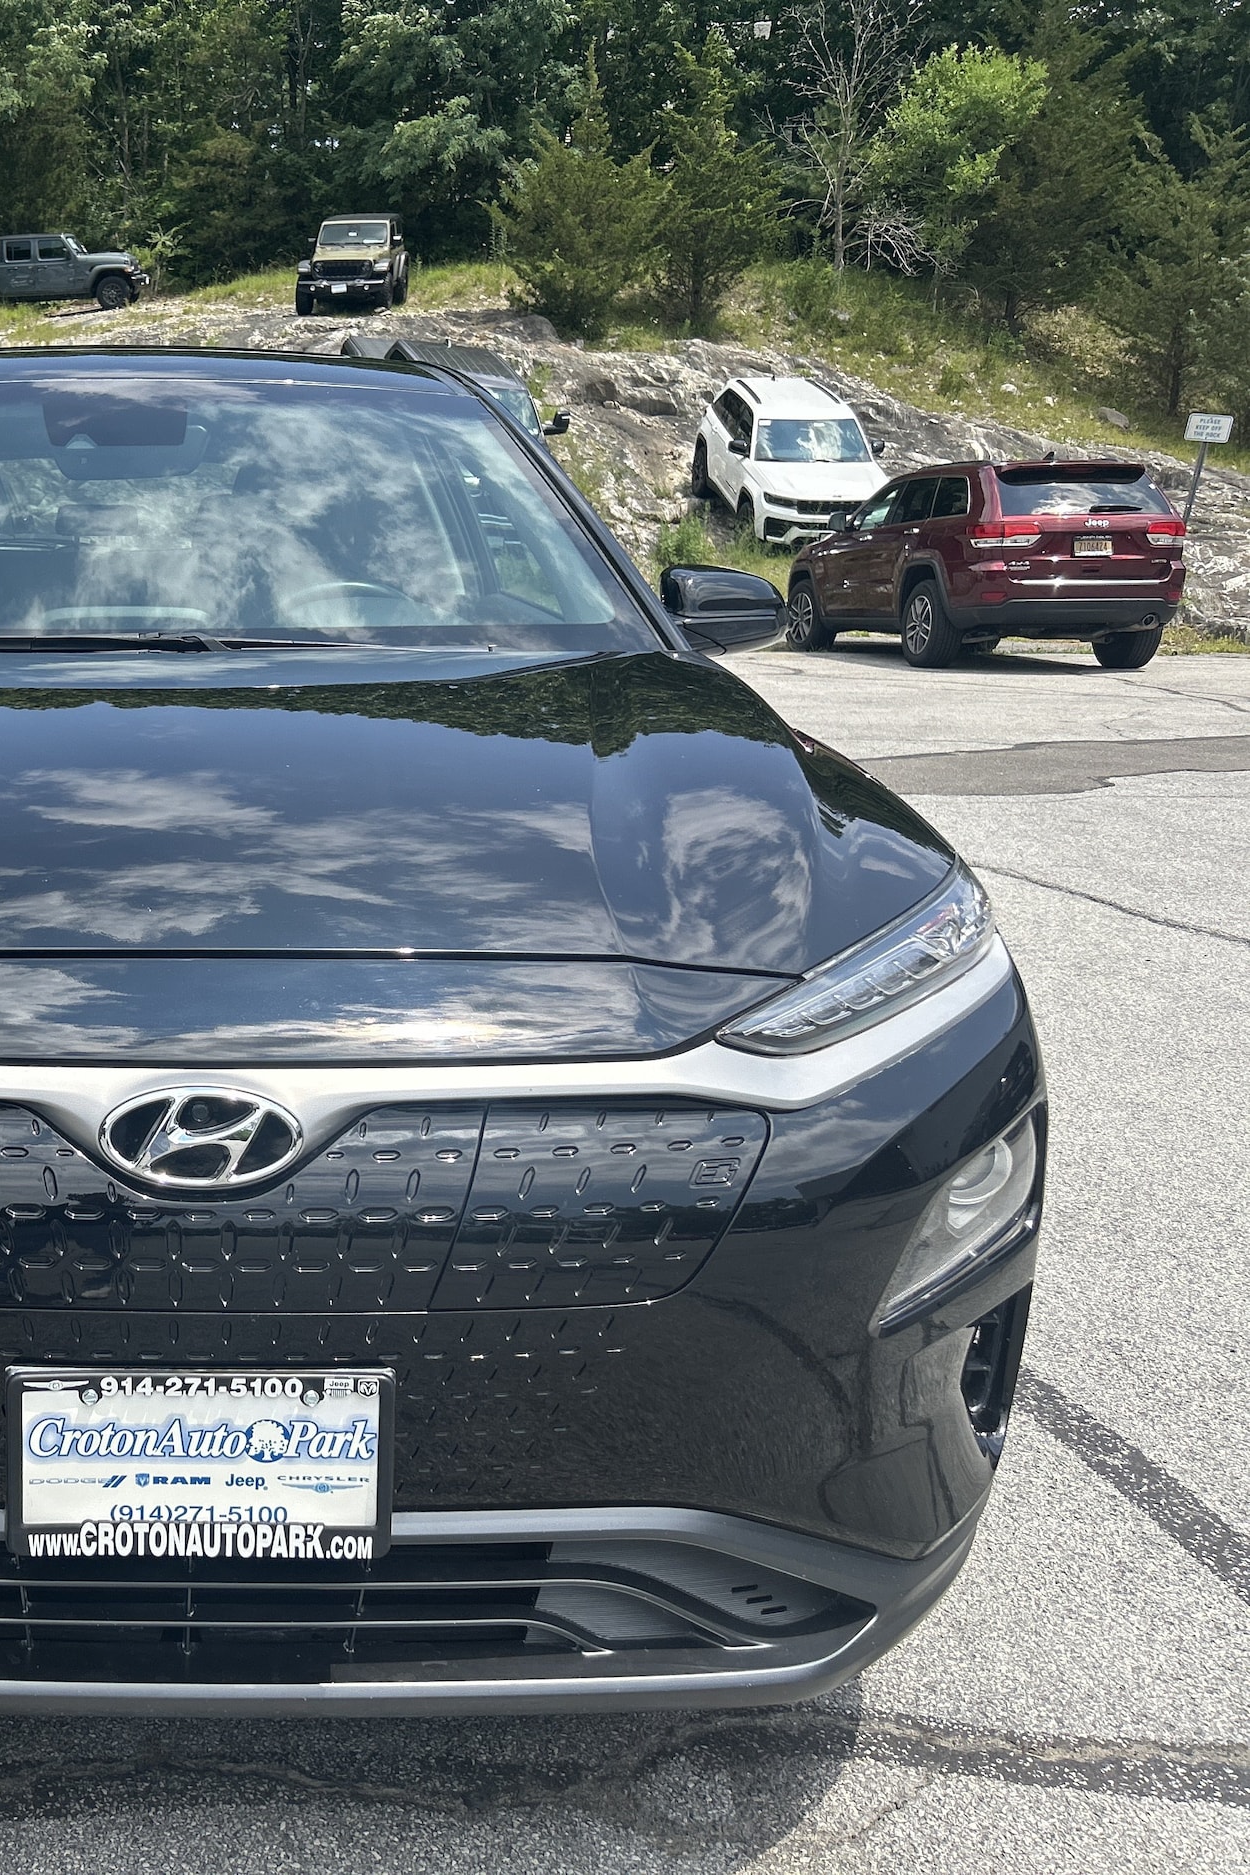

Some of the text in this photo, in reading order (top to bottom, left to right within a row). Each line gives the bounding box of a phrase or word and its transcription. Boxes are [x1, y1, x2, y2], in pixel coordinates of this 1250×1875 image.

[1084, 518, 1110, 528] Jeep
[100, 1376, 303, 1398] 914-271-5100
[329, 1380, 350, 1388] Jeep
[283, 1417, 377, 1460] Park
[152, 1476, 211, 1485] RAM
[225, 1473, 266, 1490] Jeep
[277, 1475, 370, 1483] CHRYSLER
[110, 1504, 288, 1524] (914)271-5100
